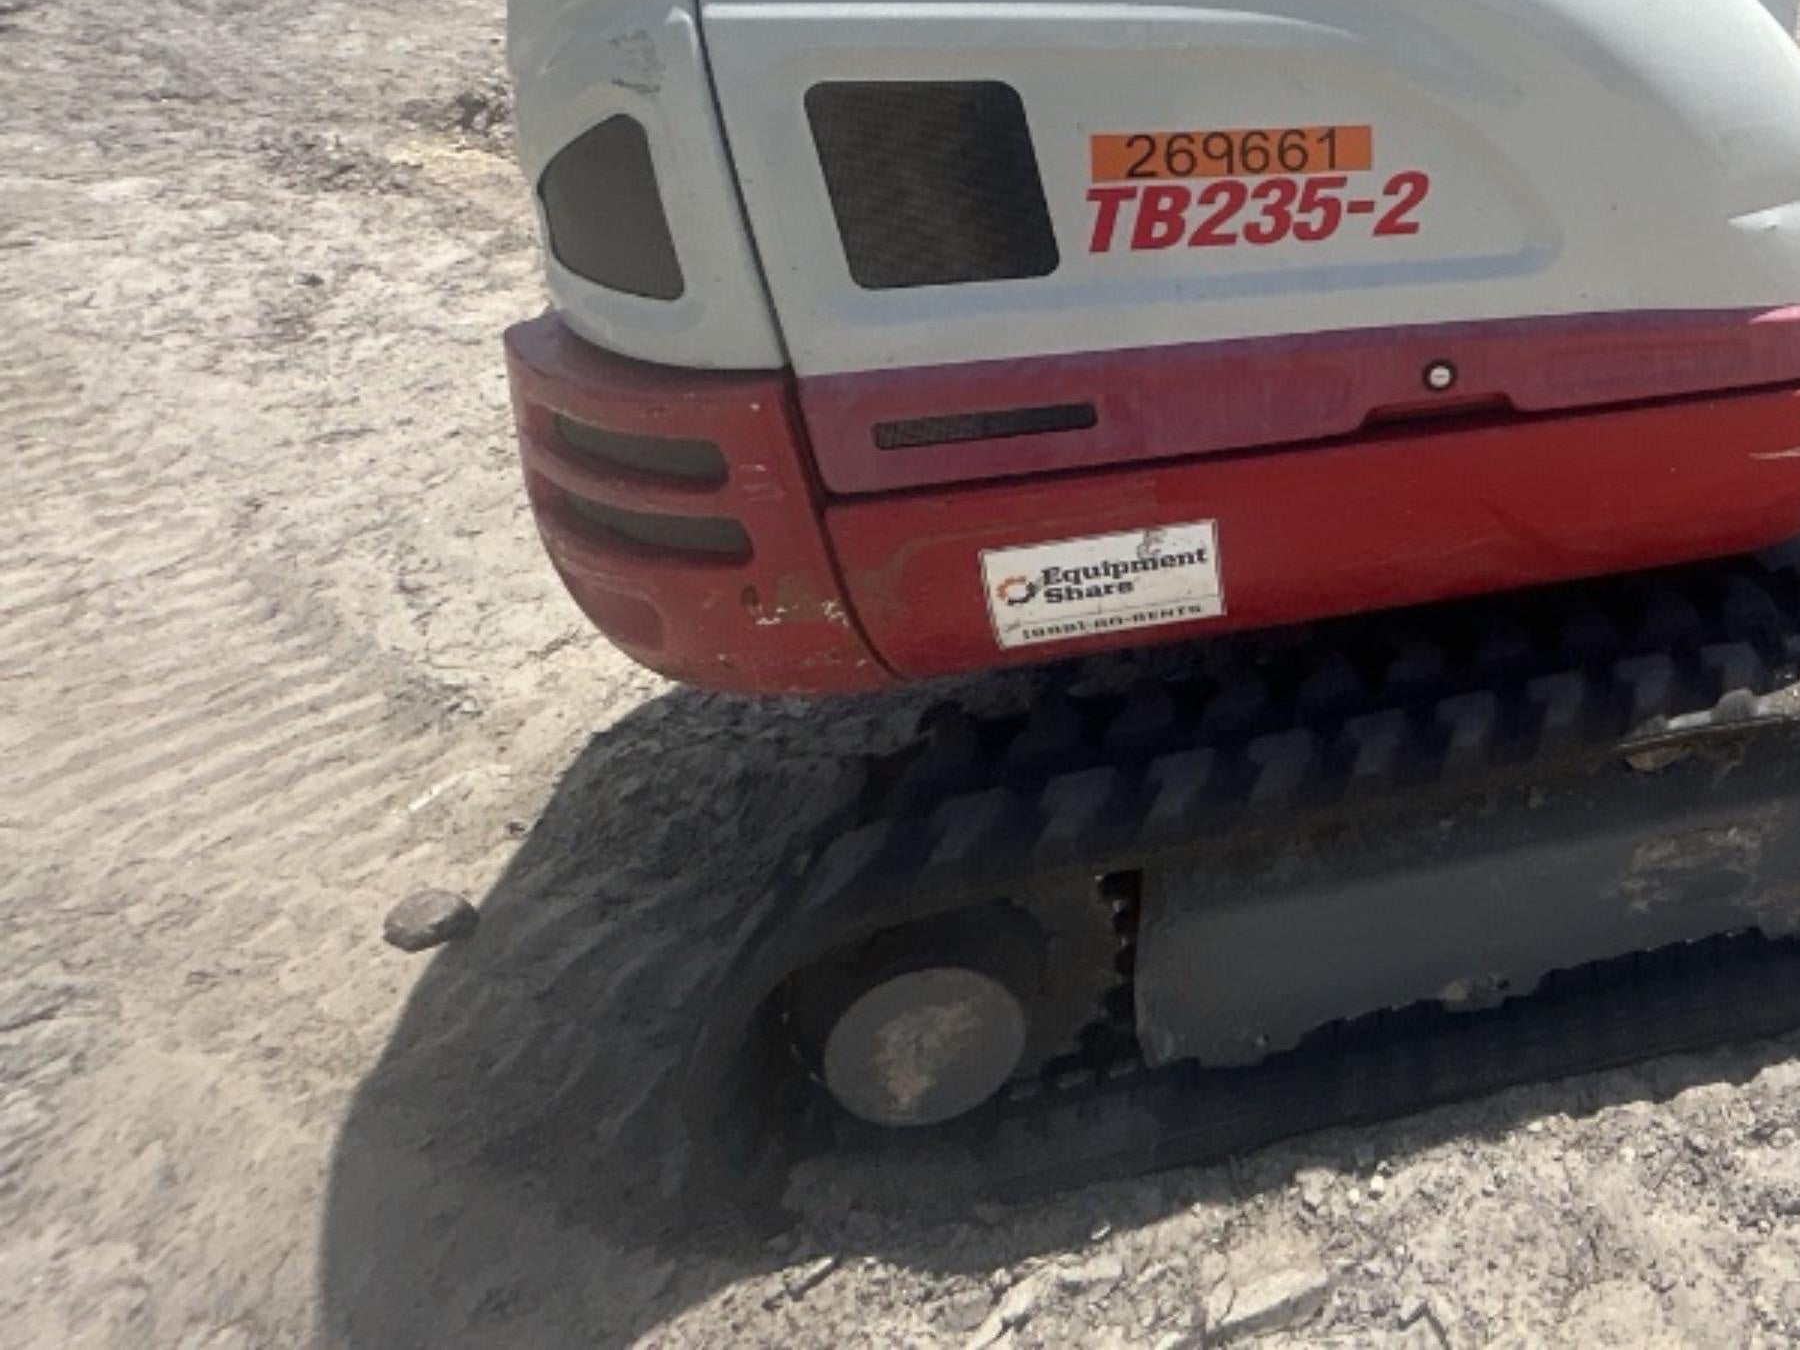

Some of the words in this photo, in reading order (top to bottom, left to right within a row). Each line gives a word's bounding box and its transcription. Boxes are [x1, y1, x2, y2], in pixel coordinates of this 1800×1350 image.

[1125, 128, 1339, 178] 269661
[1085, 171, 1430, 254] TB235-2
[1041, 548, 1208, 586] Equipment
[1043, 580, 1135, 603] Share
